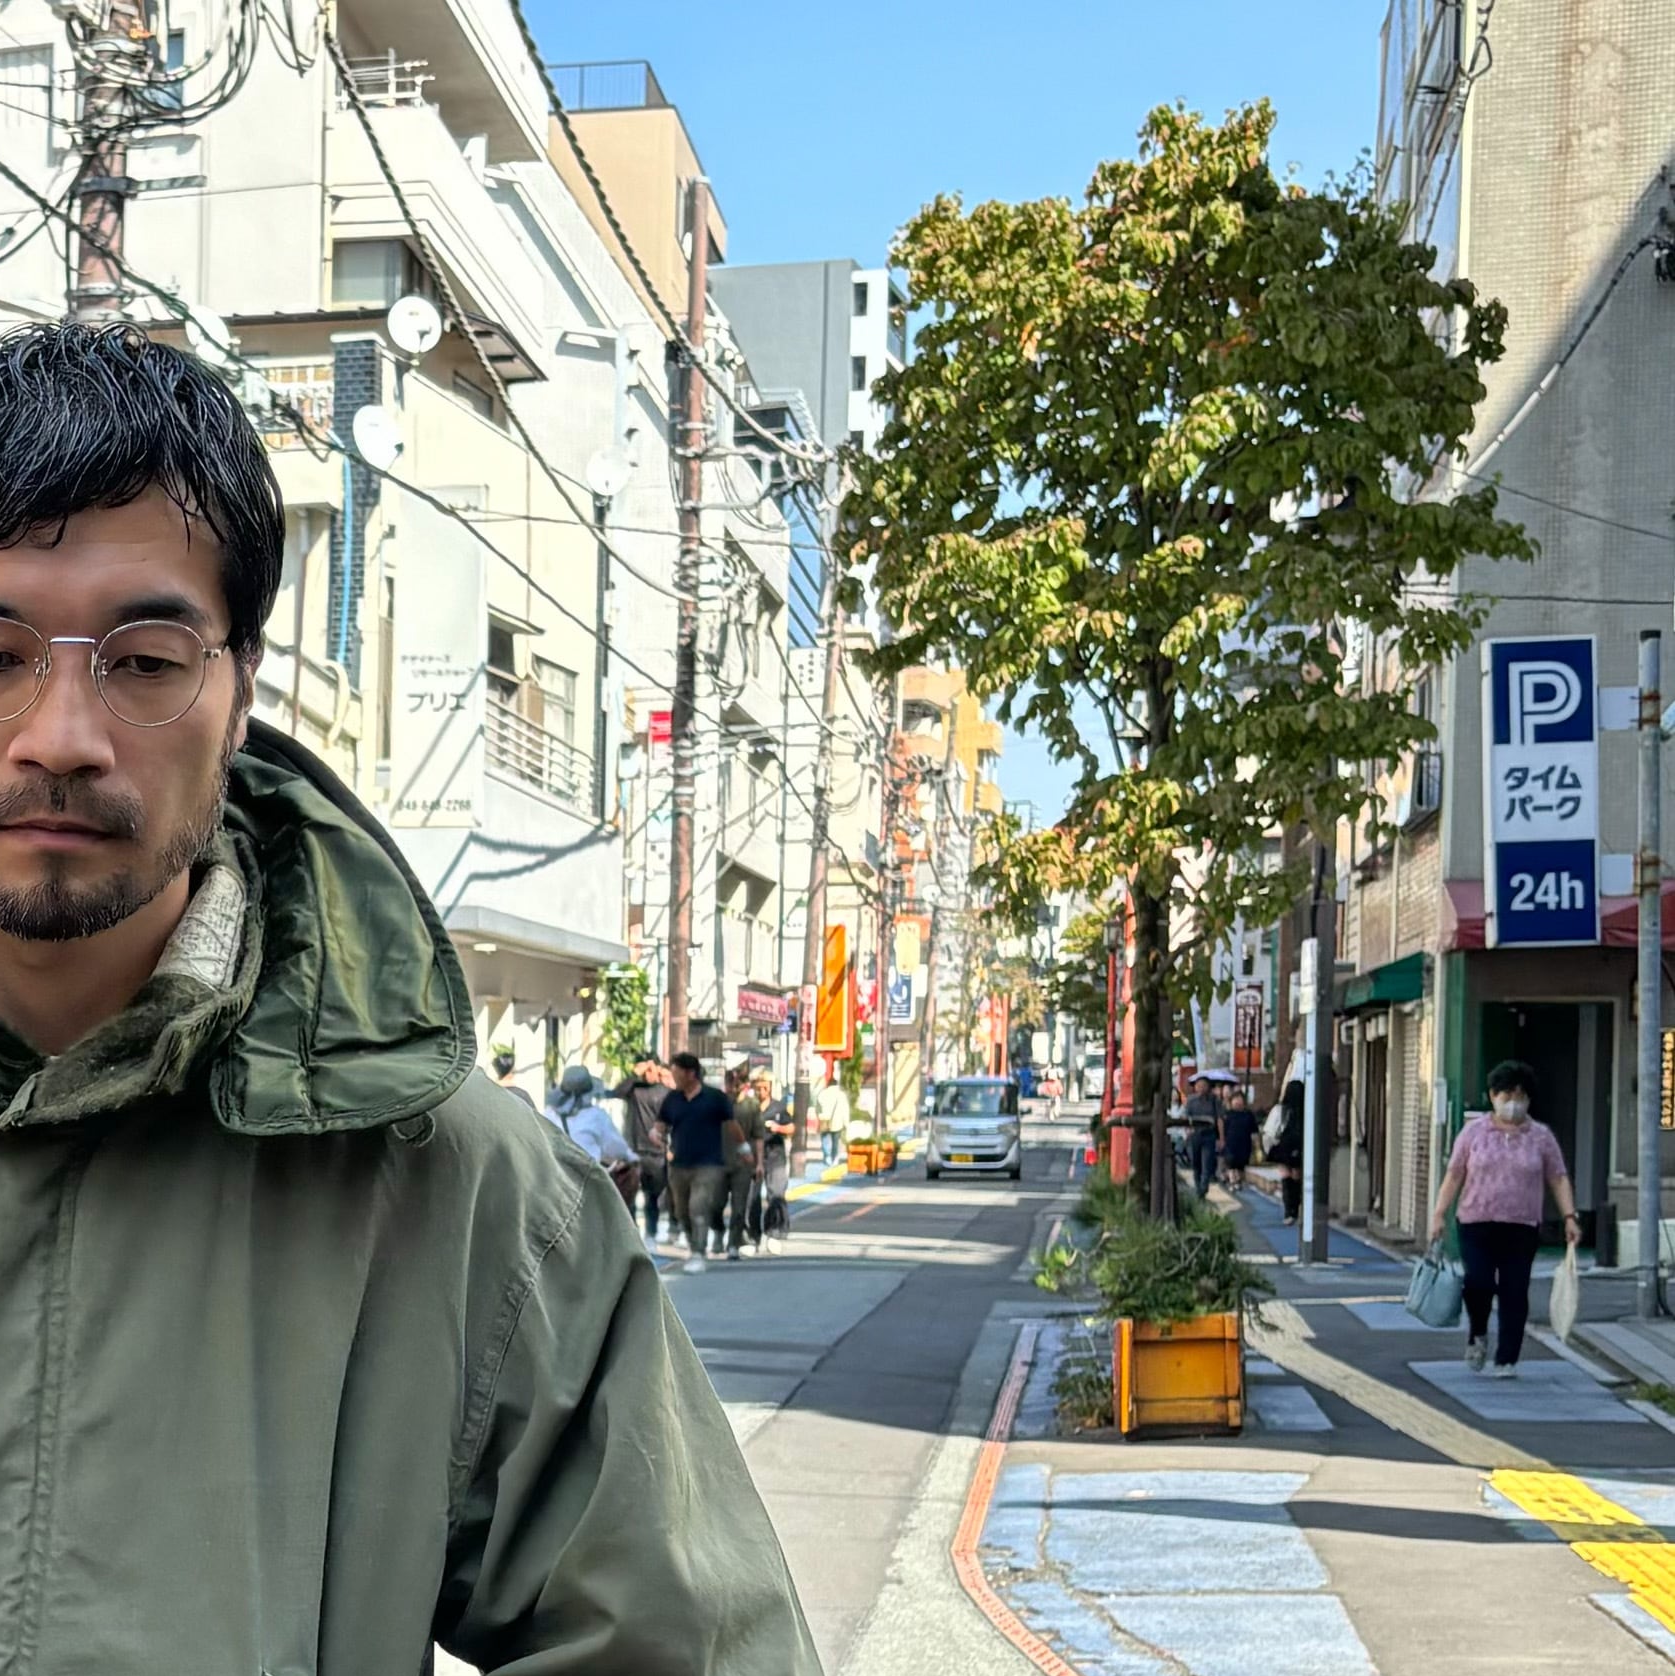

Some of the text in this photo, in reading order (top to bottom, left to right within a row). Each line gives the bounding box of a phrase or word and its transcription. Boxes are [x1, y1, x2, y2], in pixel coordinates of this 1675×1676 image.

[1509, 661, 1582, 744] P
[1504, 765, 1581, 791] タイム
[1504, 796, 1581, 822] パーク
[1510, 871, 1584, 911] 24h
